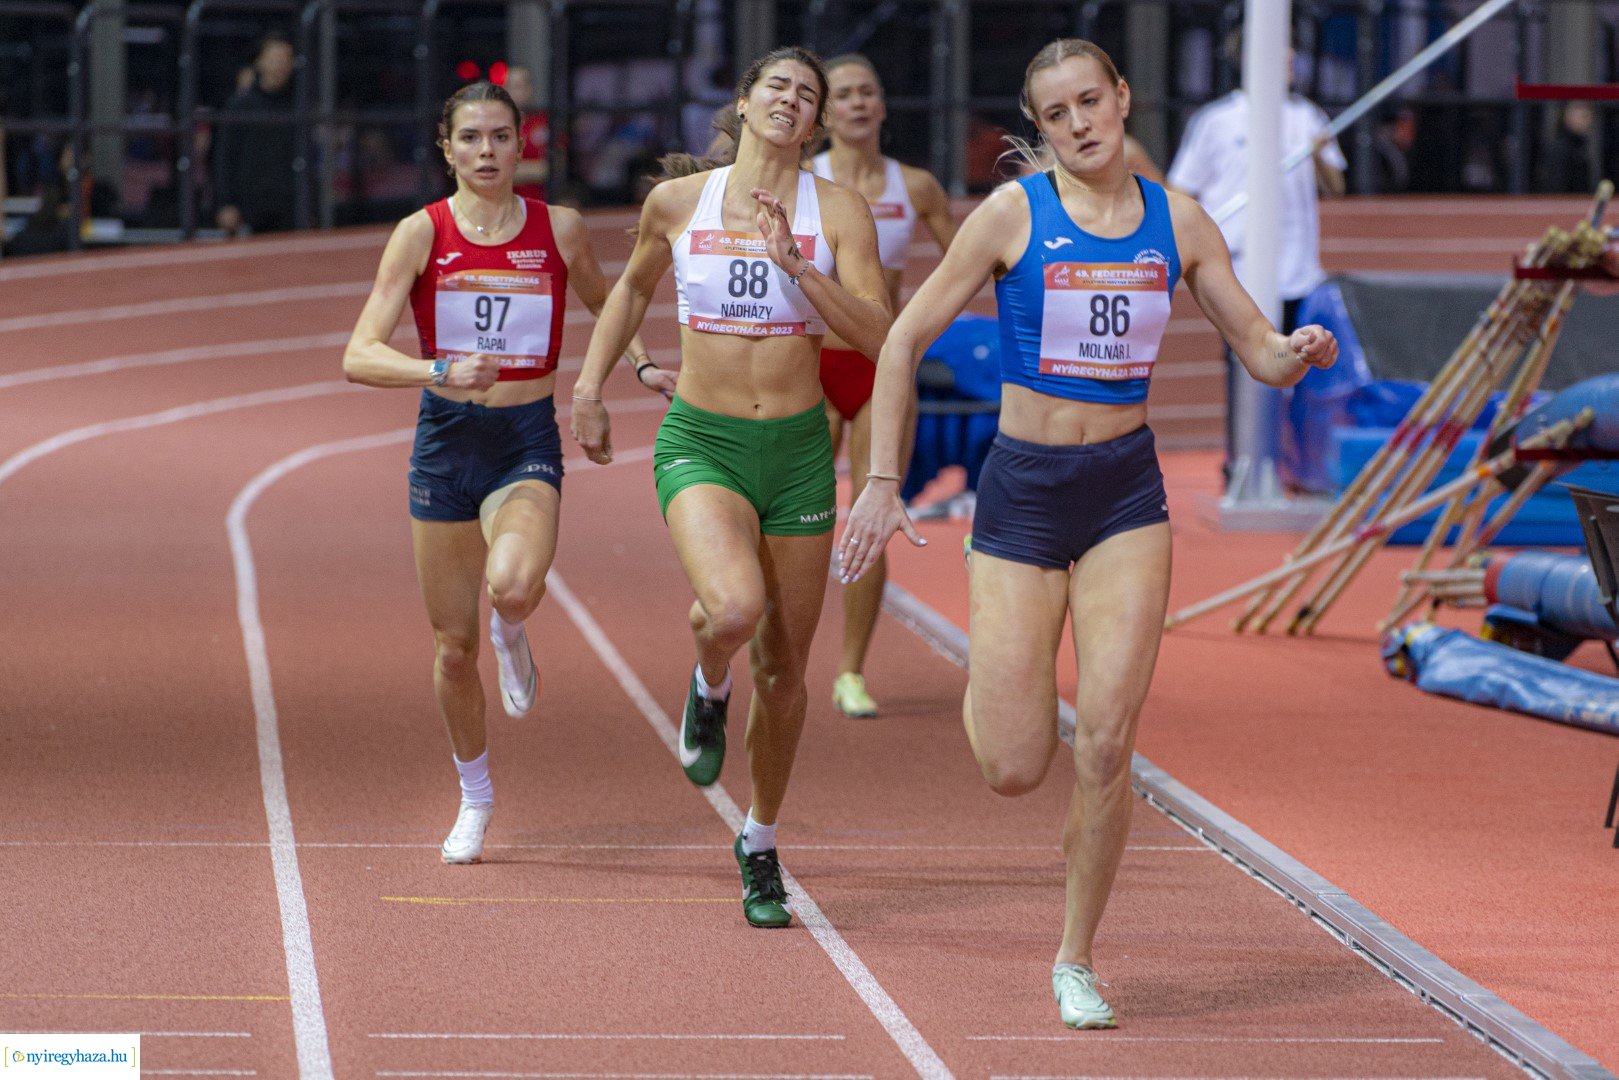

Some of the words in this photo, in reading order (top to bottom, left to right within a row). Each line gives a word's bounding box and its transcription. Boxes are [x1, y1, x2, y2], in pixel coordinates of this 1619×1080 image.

[719, 237, 732, 245] 49.
[506, 250, 547, 259] IKARUS
[728, 259, 769, 299] 88
[1075, 269, 1089, 278] 49.
[1091, 268, 1158, 279] FEDETTPÁLYÁS
[475, 296, 511, 332] 97
[721, 302, 773, 320] NÁDHÁZY
[1089, 293, 1131, 337] 86
[696, 321, 768, 334] NYÍREGYHÁZA
[769, 326, 794, 335] 2023
[477, 337, 506, 351] RAPAI
[1079, 341, 1125, 360] MOLNÁR
[1052, 363, 1128, 377] NYÍREGYHÁZA
